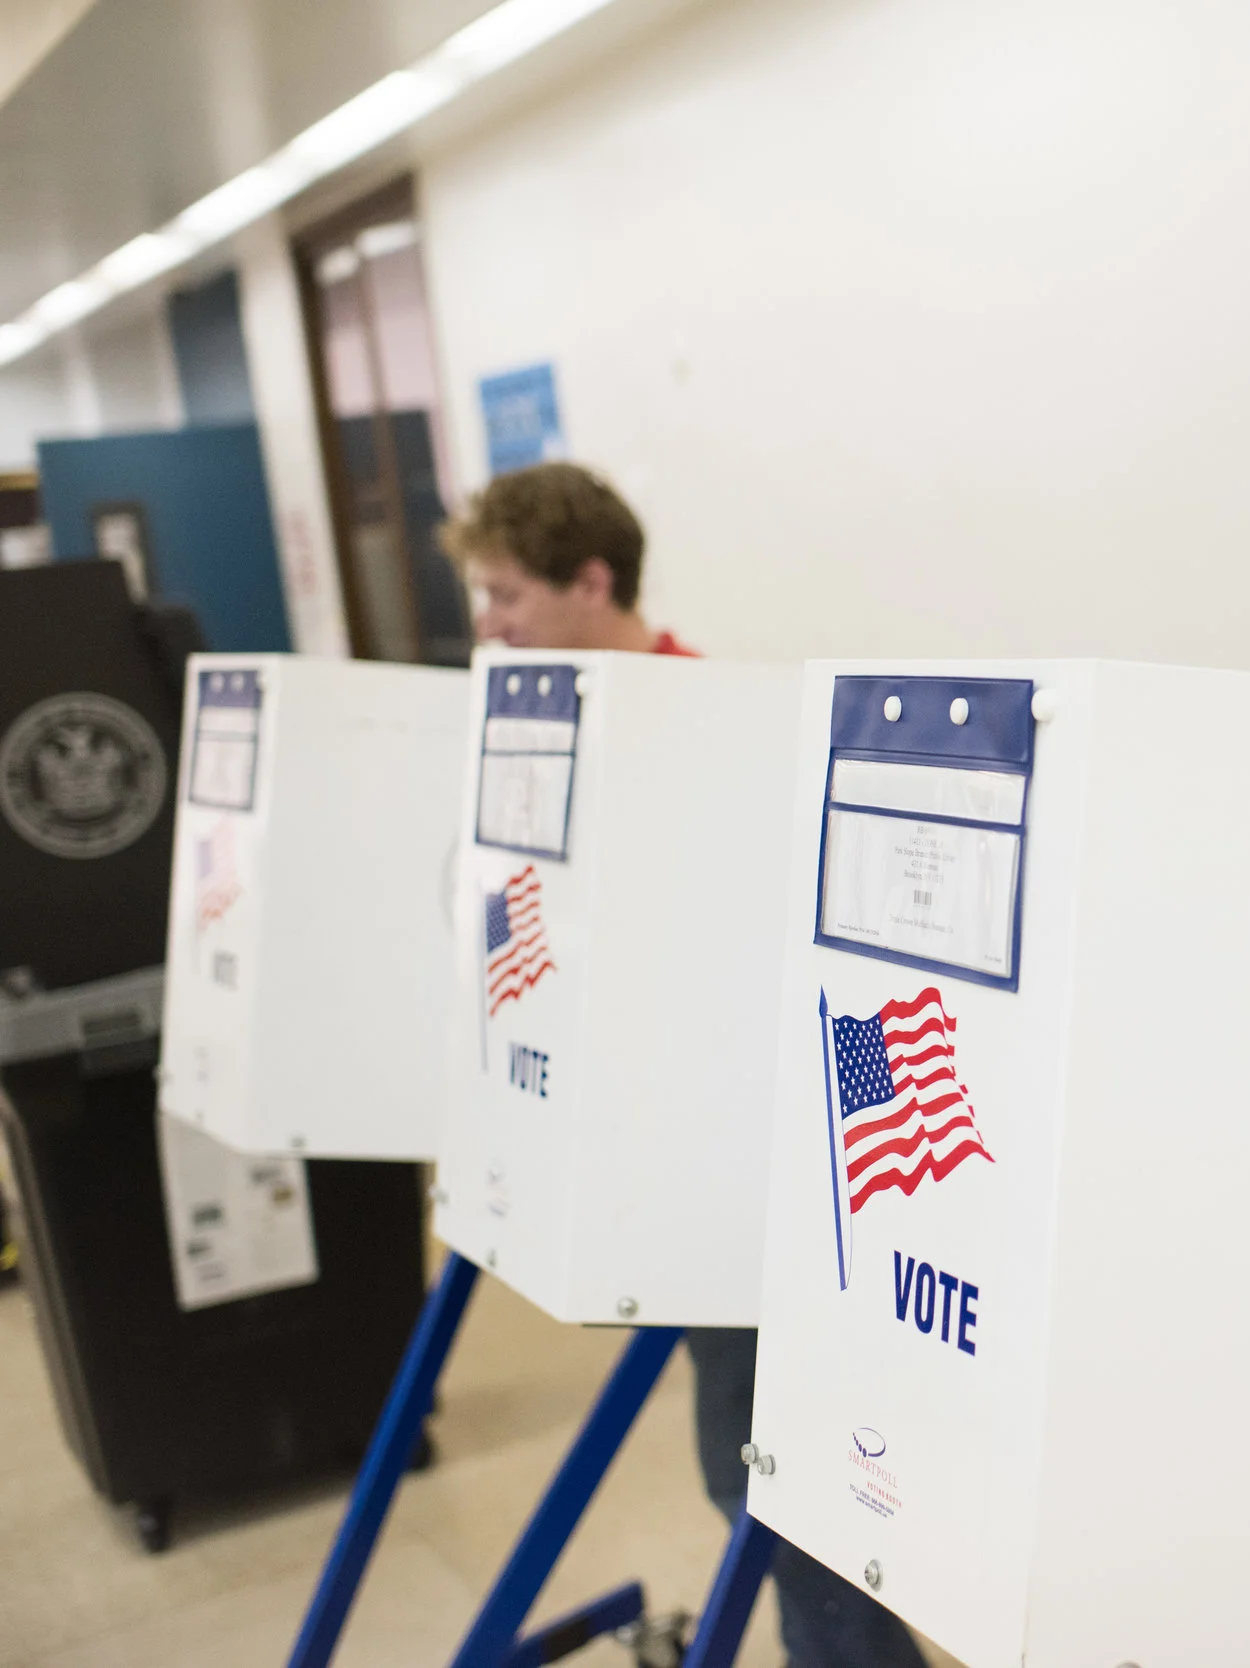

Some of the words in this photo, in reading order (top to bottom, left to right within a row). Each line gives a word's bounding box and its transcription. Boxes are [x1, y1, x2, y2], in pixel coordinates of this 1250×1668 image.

[508, 1040, 549, 1099] VOTE
[892, 1249, 980, 1357] VOTE
[848, 1449, 898, 1488] SMARTPOLL
[867, 1481, 885, 1498] VOTING
